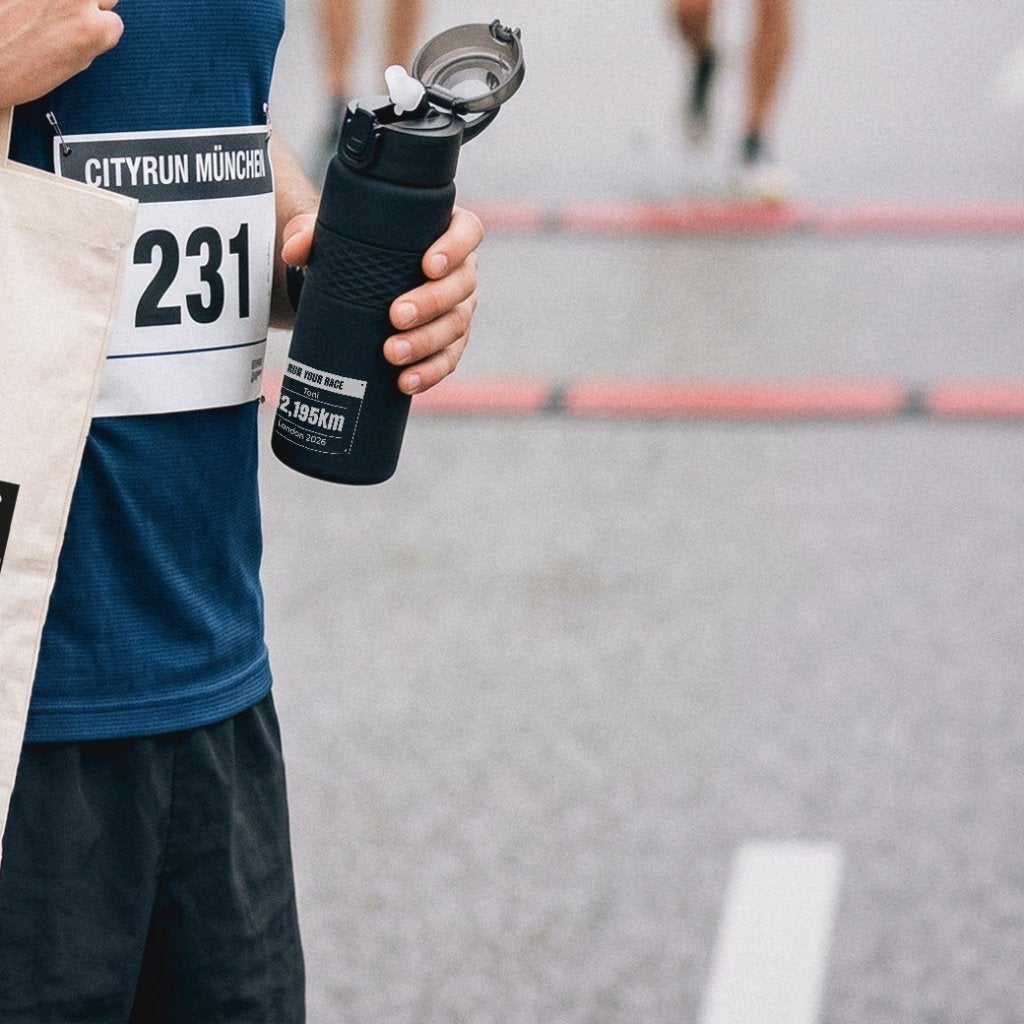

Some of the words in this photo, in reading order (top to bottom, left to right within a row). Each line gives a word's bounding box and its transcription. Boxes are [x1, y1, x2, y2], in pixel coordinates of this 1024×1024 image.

[85, 154, 189, 188] CITYRUN
[196, 145, 265, 183] MÜNCHEN
[133, 223, 251, 328] 231
[303, 387, 320, 399] Toni
[304, 369, 324, 384] YOUR
[323, 376, 344, 390] RACE
[279, 393, 345, 432] 2,195km
[278, 419, 304, 439] London
[305, 433, 327, 446] 2026
